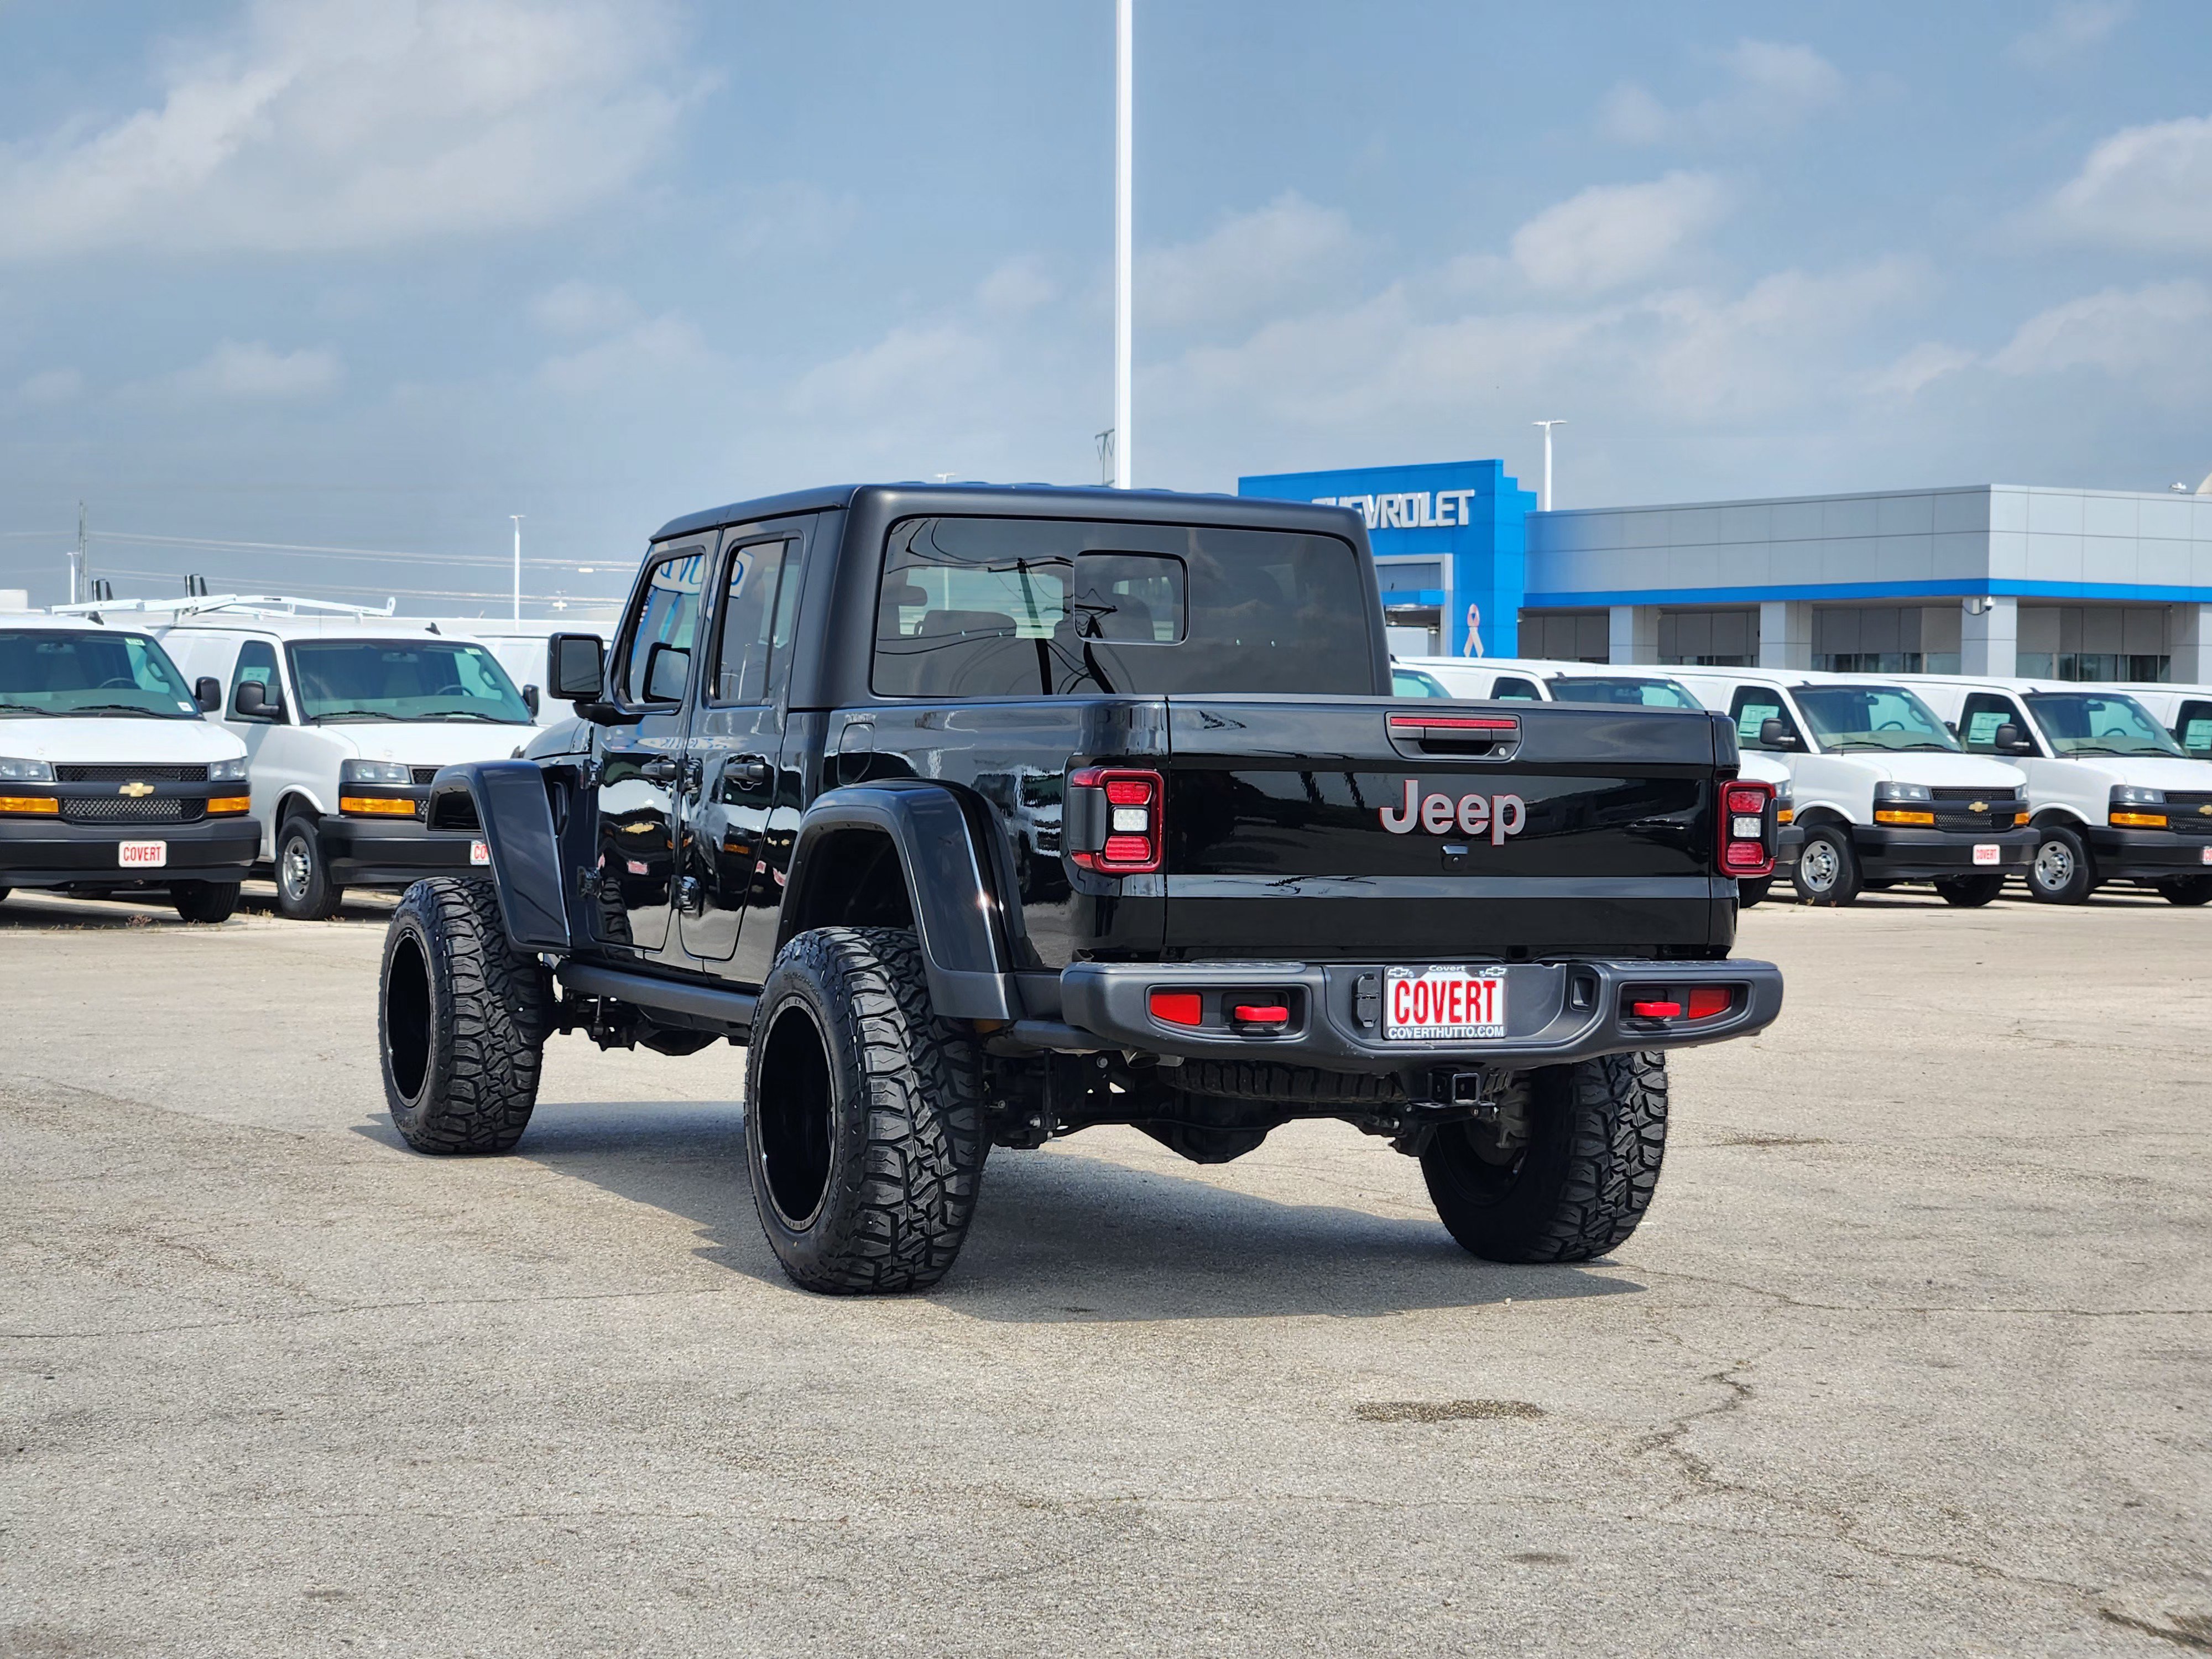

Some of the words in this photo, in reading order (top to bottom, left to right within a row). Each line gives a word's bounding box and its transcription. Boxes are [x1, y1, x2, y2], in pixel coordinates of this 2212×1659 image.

[1312, 489, 1475, 529] VROLET
[1379, 780, 1526, 846] Jeep
[124, 847, 161, 861] COVERT
[474, 846, 488, 859] CO
[1395, 980, 1496, 1024] COVERT
[1388, 1027, 1504, 1037] COVERTHUTTO.COM
